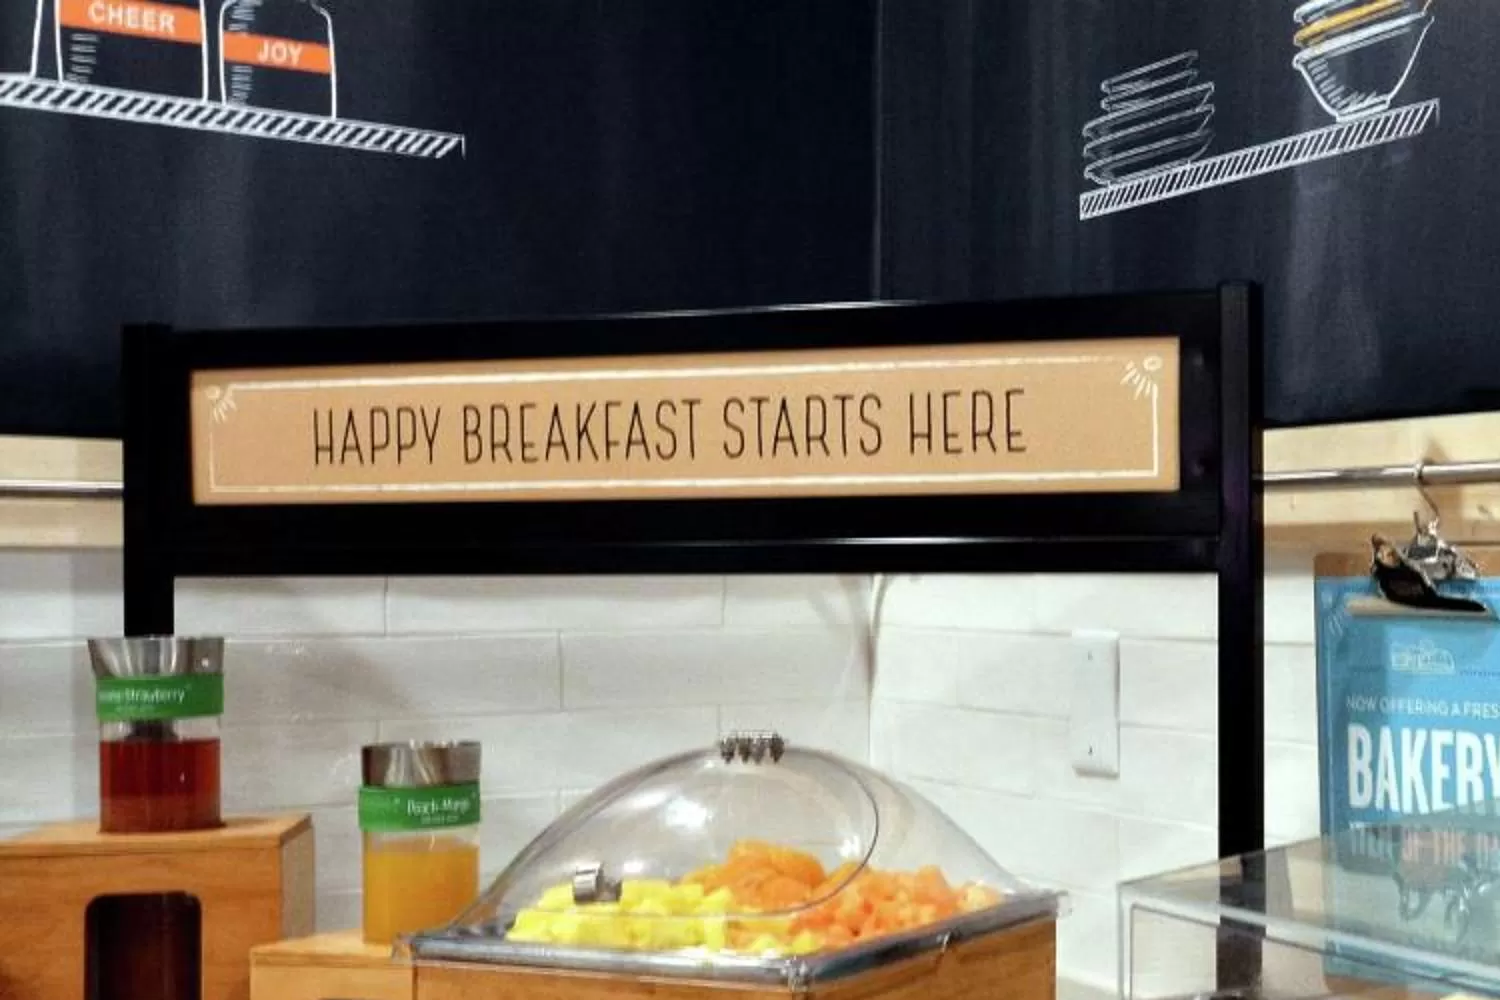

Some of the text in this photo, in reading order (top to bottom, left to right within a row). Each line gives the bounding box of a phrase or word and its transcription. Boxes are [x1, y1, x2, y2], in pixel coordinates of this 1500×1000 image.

[87, 1, 176, 34] CHEER
[257, 40, 303, 66] JOY
[312, 388, 1028, 467] HAPPY BREAKFAST STARTS HERE
[1346, 694, 1377, 713] NOW
